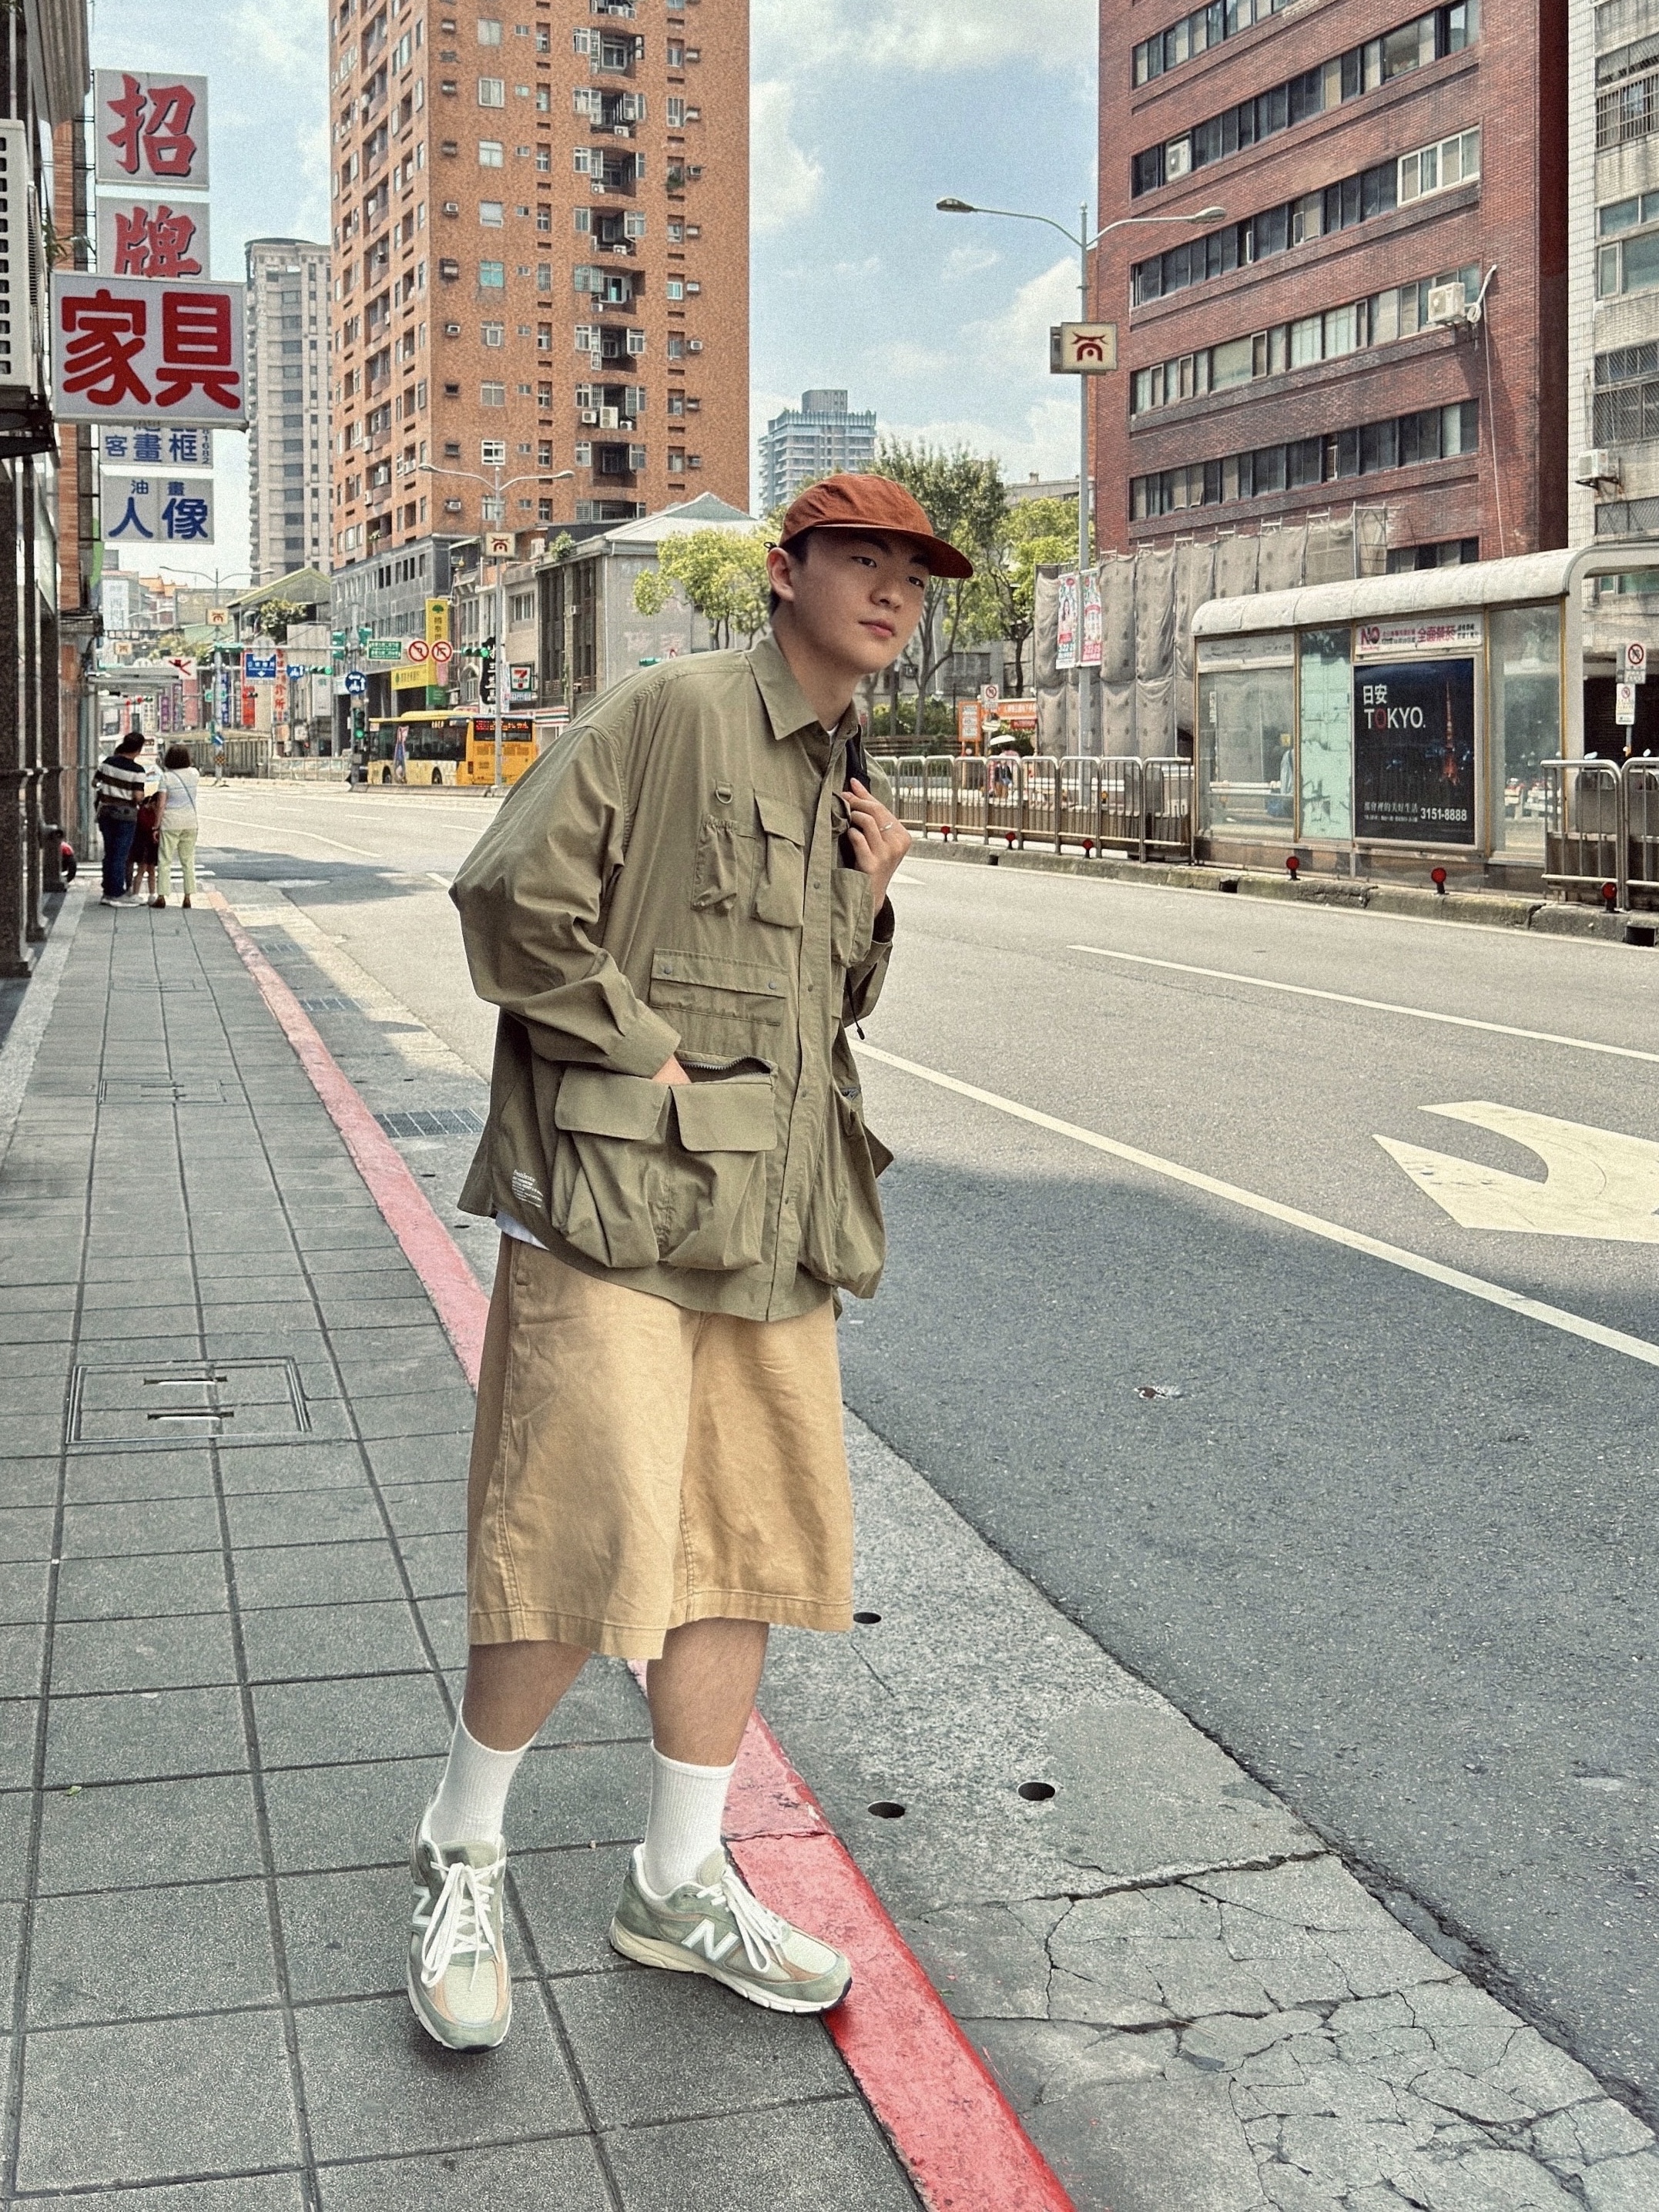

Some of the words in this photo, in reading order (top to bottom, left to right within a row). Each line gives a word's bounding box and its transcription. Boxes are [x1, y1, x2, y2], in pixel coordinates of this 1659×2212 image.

[106, 73, 202, 278] 招牌
[61, 288, 241, 410] 家具
[108, 496, 209, 539] 人像
[1363, 684, 1387, 705] 日安
[1364, 706, 1426, 729] TOKYO.
[1420, 807, 1467, 821] 3151-8888
[681, 1919, 739, 1962] N
